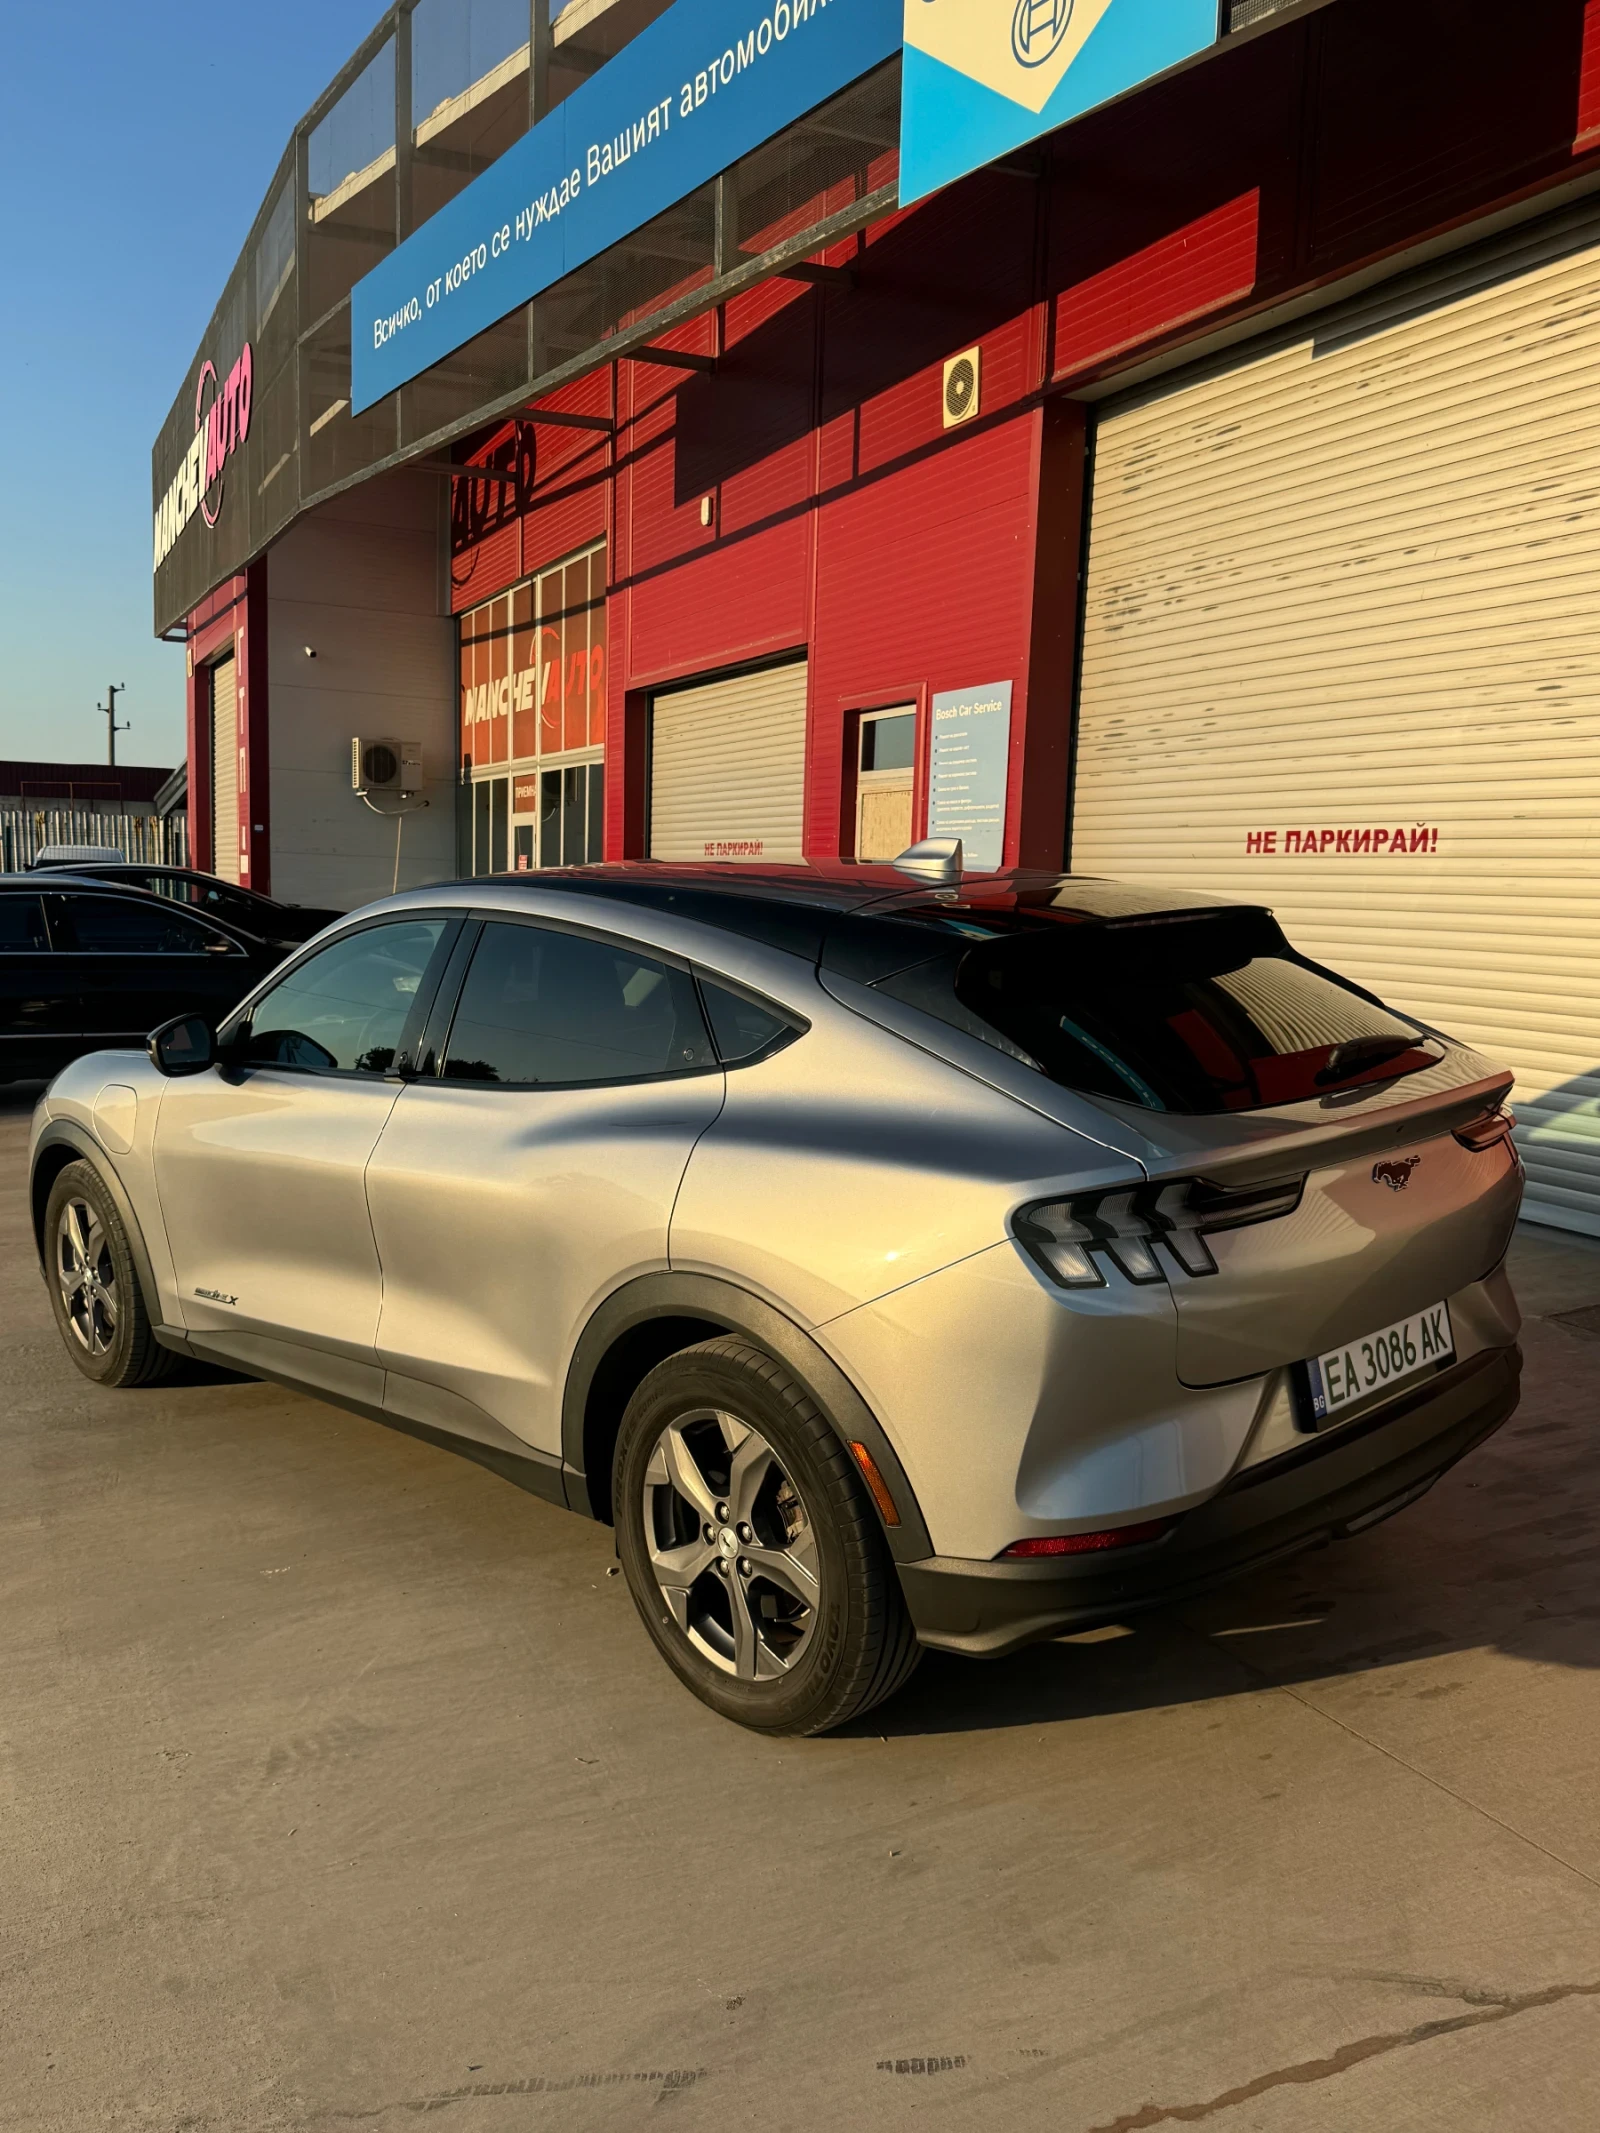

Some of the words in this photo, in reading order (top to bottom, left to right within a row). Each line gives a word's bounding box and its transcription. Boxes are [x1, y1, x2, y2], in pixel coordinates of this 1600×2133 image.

[373, 296, 422, 349] Всичко,
[426, 277, 442, 309] от
[445, 243, 487, 295] което
[492, 224, 510, 258] се
[516, 168, 581, 242] нуждае
[587, 96, 672, 187] Вашият
[935, 705, 957, 721] Bosch
[959, 704, 973, 717] Car
[973, 699, 1003, 715] Service
[704, 842, 715, 856] НЕ
[716, 839, 763, 856] ПАРКИРАЙ!
[1246, 831, 1277, 854] НЕ
[1284, 822, 1438, 853] ПАРКИРАЙ!
[1324, 1350, 1361, 1406] EA
[1361, 1323, 1417, 1387] 3086
[1421, 1308, 1448, 1360] AK
[1313, 1395, 1325, 1411] BG
